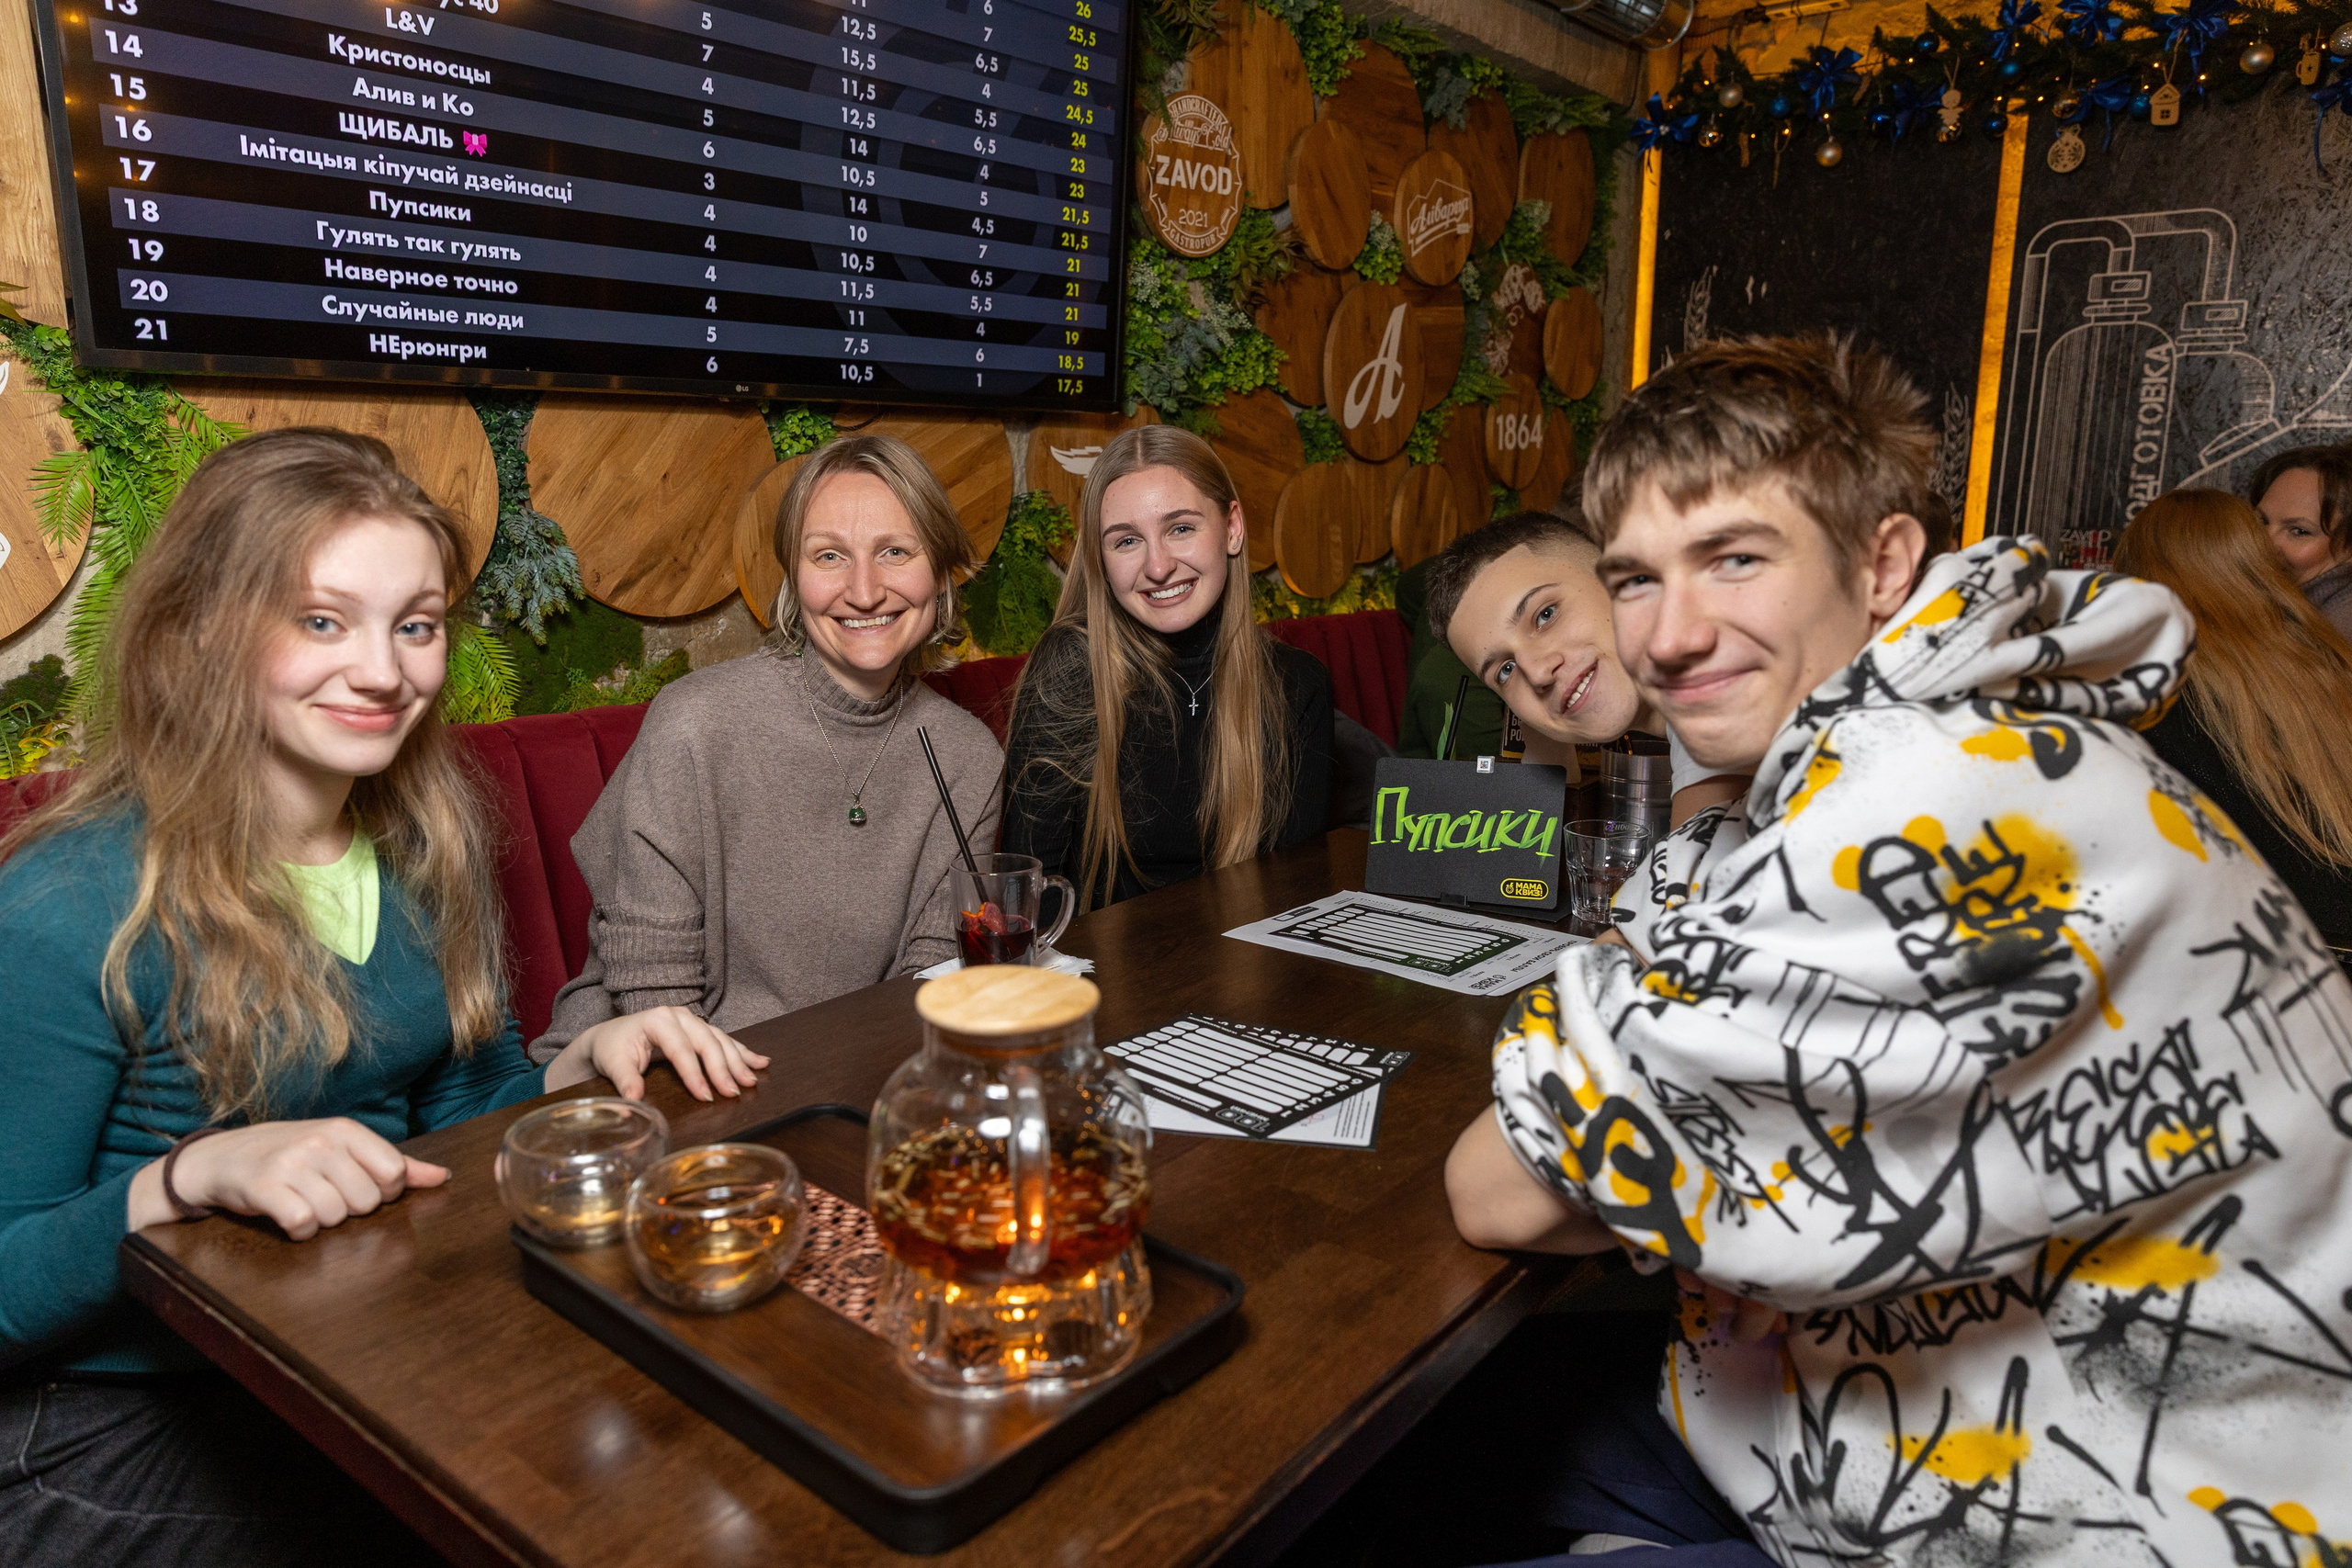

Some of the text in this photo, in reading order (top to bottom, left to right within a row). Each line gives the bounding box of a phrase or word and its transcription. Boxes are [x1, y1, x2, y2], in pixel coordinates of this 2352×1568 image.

[983, 0, 1096, 47] 6 25,5
[1076, 1, 1091, 18] 26
[701, 11, 1093, 125] 5 15,5 4 24,5
[842, 16, 1088, 96] 12,5 6,5 25
[983, 26, 1089, 71] 7 25
[384, 7, 1085, 174] L&V 4 12,5 6,5 23
[702, 43, 1086, 148] 7 11,5 5,5 24
[1170, 97, 1224, 129] HANDCRAFTED
[104, 28, 1090, 225] 14 Алив и Ко 6 10,5 5 21,5
[328, 33, 491, 85] Кристоносцы
[703, 108, 714, 127] 5
[850, 138, 868, 156] 14
[979, 164, 989, 180] 4
[1069, 183, 1084, 198] 23
[109, 73, 1088, 250] 15 ЩИБАЛЬ 3 14 4,5 21,5
[1155, 153, 1233, 197] ZAVOD
[114, 115, 1080, 273] 16 Імітацыя кіпучай дзейнасці 4 10 7 21
[119, 156, 1080, 297] 17 Пупсики 4 10,5 6,5 21
[1169, 228, 1217, 250] GASTROPUB
[1178, 208, 1209, 229] 2021
[123, 197, 1079, 321] 18 Гулять так гулять 4 11,5 5,5 21
[128, 238, 1079, 345] 19 Наверное точно 4 11 4 19
[130, 277, 1084, 371] 20 Случайные люди 5 7,5 6 18,5
[134, 318, 1084, 395] 21 НЕрюнгри 6 10,5 1 17,5
[741, 385, 750, 393] LG
[1496, 413, 1544, 451] 1864
[2122, 341, 2175, 527] ОДГОТОВКА
[1509, 728, 1525, 742] РО
[1370, 785, 1558, 863] Пупсики
[1515, 882, 1543, 891] МАМА
[1515, 888, 1544, 897] КВИЗ!
[1214, 1107, 1272, 1134] 100
[1280, 1110, 1293, 1118] 1
[1294, 1102, 1310, 1111] 2
[1307, 1097, 1323, 1105] 3
